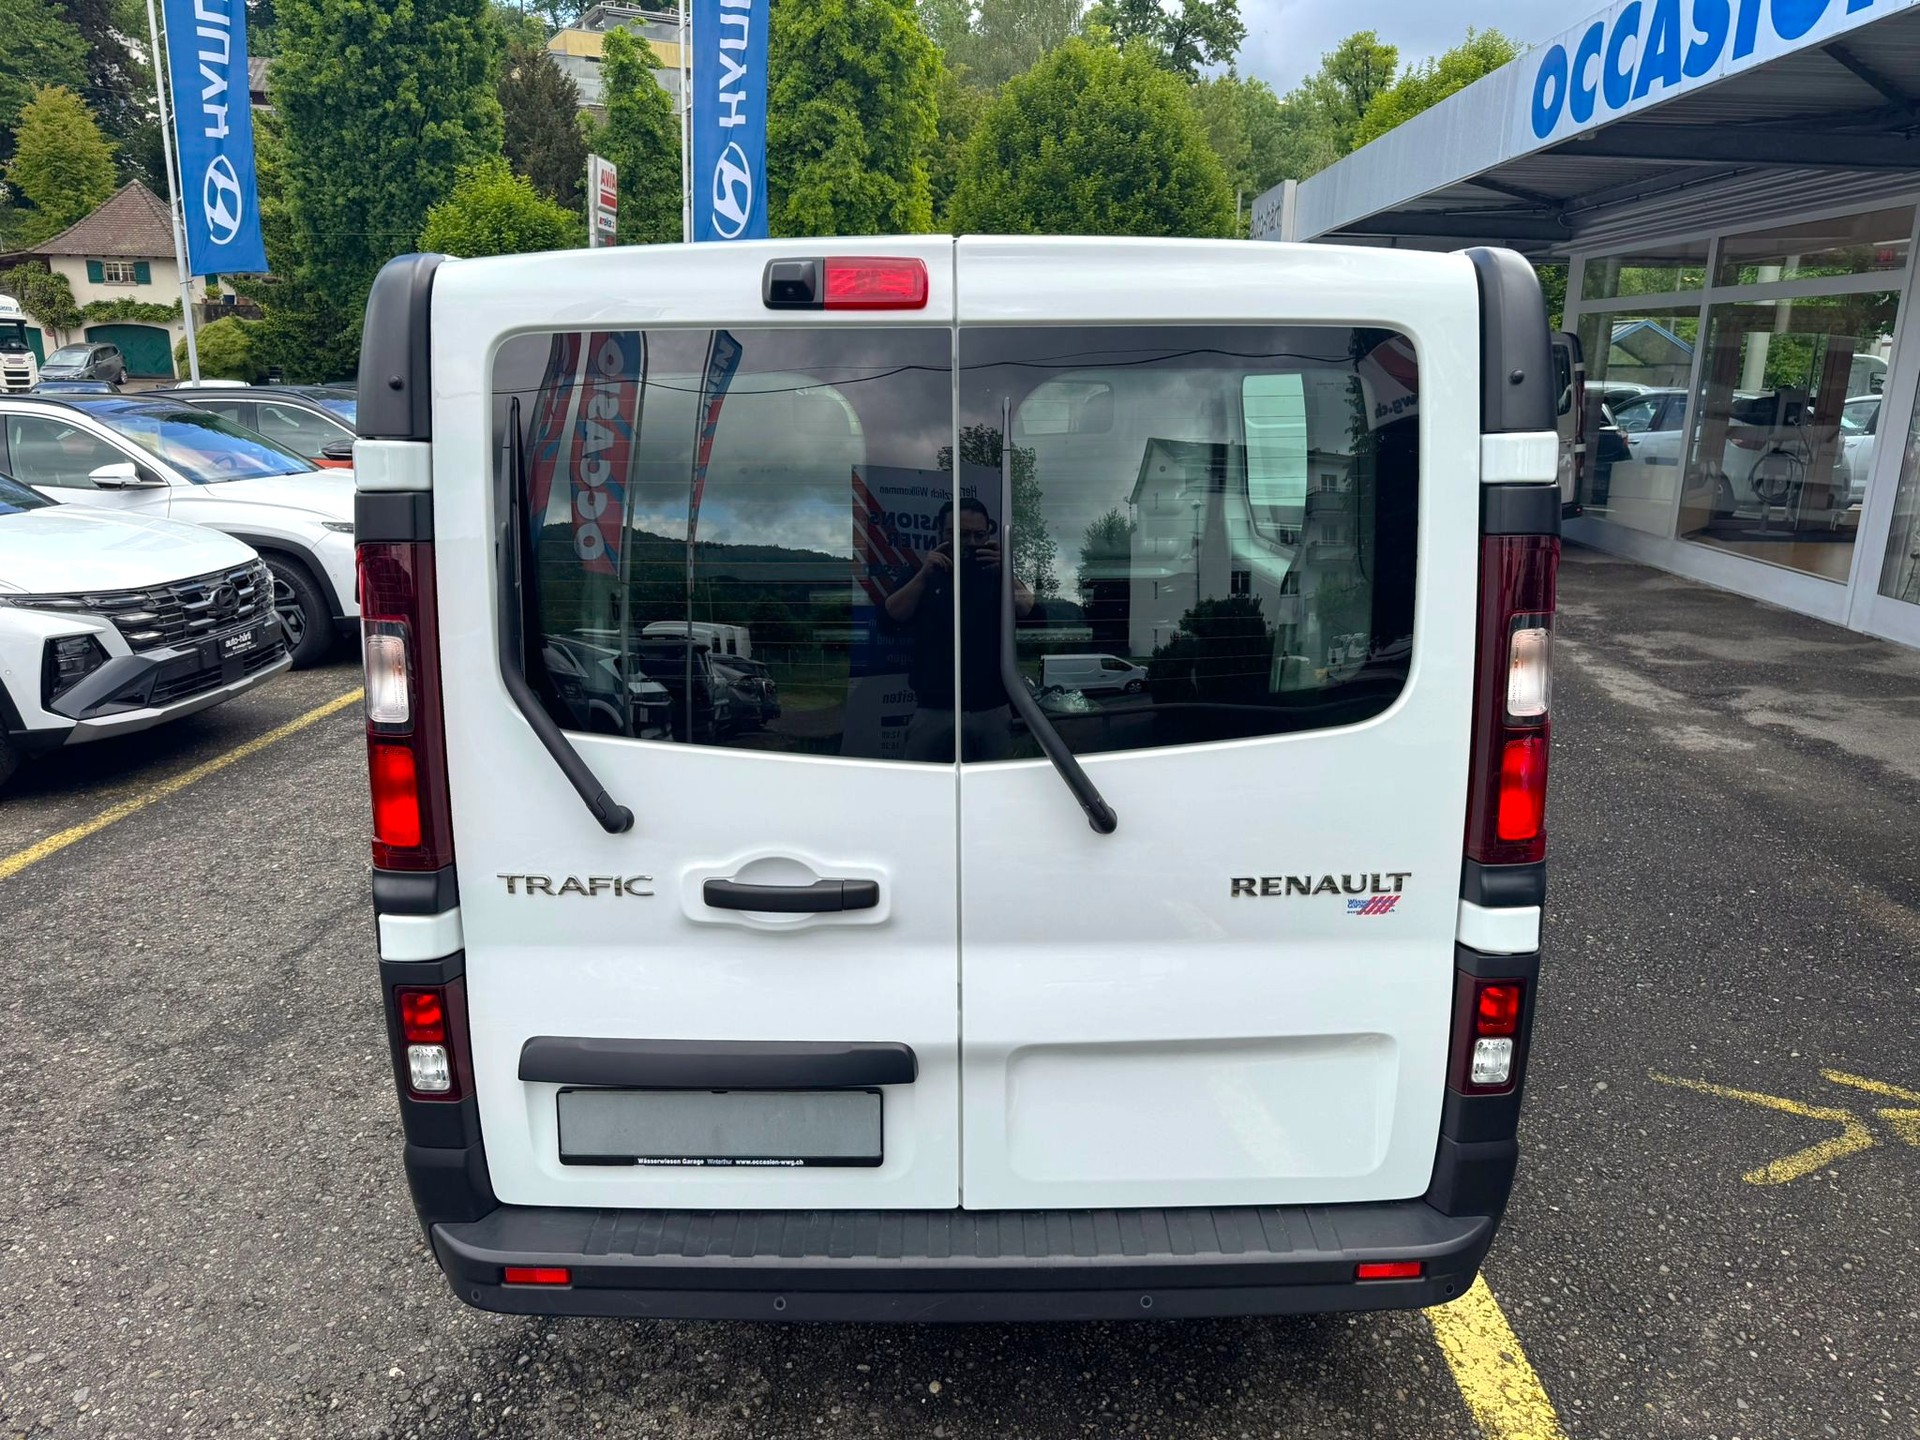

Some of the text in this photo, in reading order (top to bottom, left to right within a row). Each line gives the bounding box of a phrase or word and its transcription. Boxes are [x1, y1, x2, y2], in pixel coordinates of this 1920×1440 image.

[719, 0, 750, 127] HYU
[601, 169, 616, 190] AVIA
[496, 872, 655, 897] TRAFIC
[1230, 872, 1413, 897] RENAULT
[681, 1157, 705, 1167] Garage
[735, 1158, 804, 1167] www.occasion-wwg.ch
